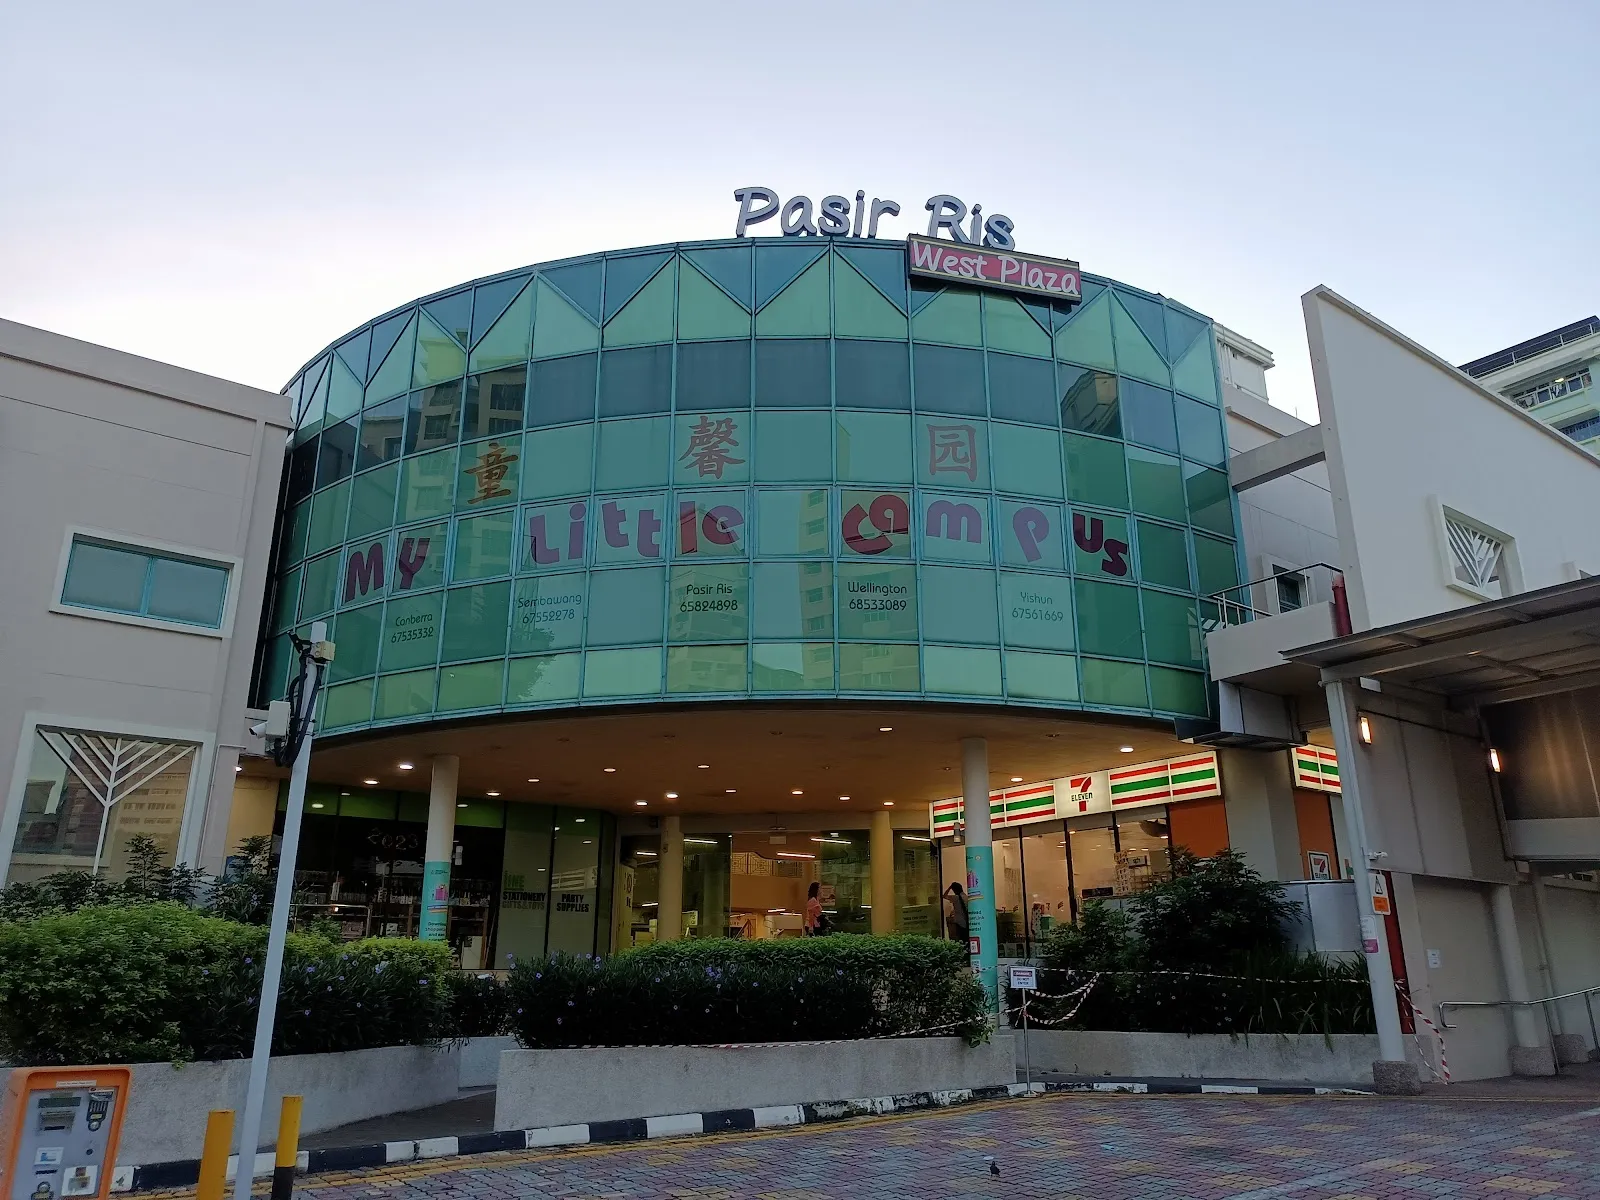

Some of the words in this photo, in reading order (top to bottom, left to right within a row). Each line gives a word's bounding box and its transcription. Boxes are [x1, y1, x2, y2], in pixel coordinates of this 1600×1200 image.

[734, 186, 900, 238] Pasir
[925, 194, 1015, 251] Ris
[912, 241, 988, 280] West
[998, 255, 1079, 295] Plaza
[529, 500, 745, 566] Little
[686, 582, 713, 597] Pasir
[717, 583, 733, 596] Ris
[847, 581, 908, 598] Wellington
[517, 593, 582, 609] Sembawang
[679, 600, 738, 612] 65824898
[848, 598, 907, 611] 68533089
[1020, 591, 1053, 606] Yishun
[395, 612, 433, 628] Canberra
[522, 608, 575, 625] 67552278
[1011, 607, 1064, 622] 67561669
[391, 628, 434, 643] 67535332
[1070, 776, 1091, 812] 7
[502, 891, 546, 901] STATIONERY
[562, 893, 584, 903] PARTY
[556, 903, 589, 912] SUPPLIES
